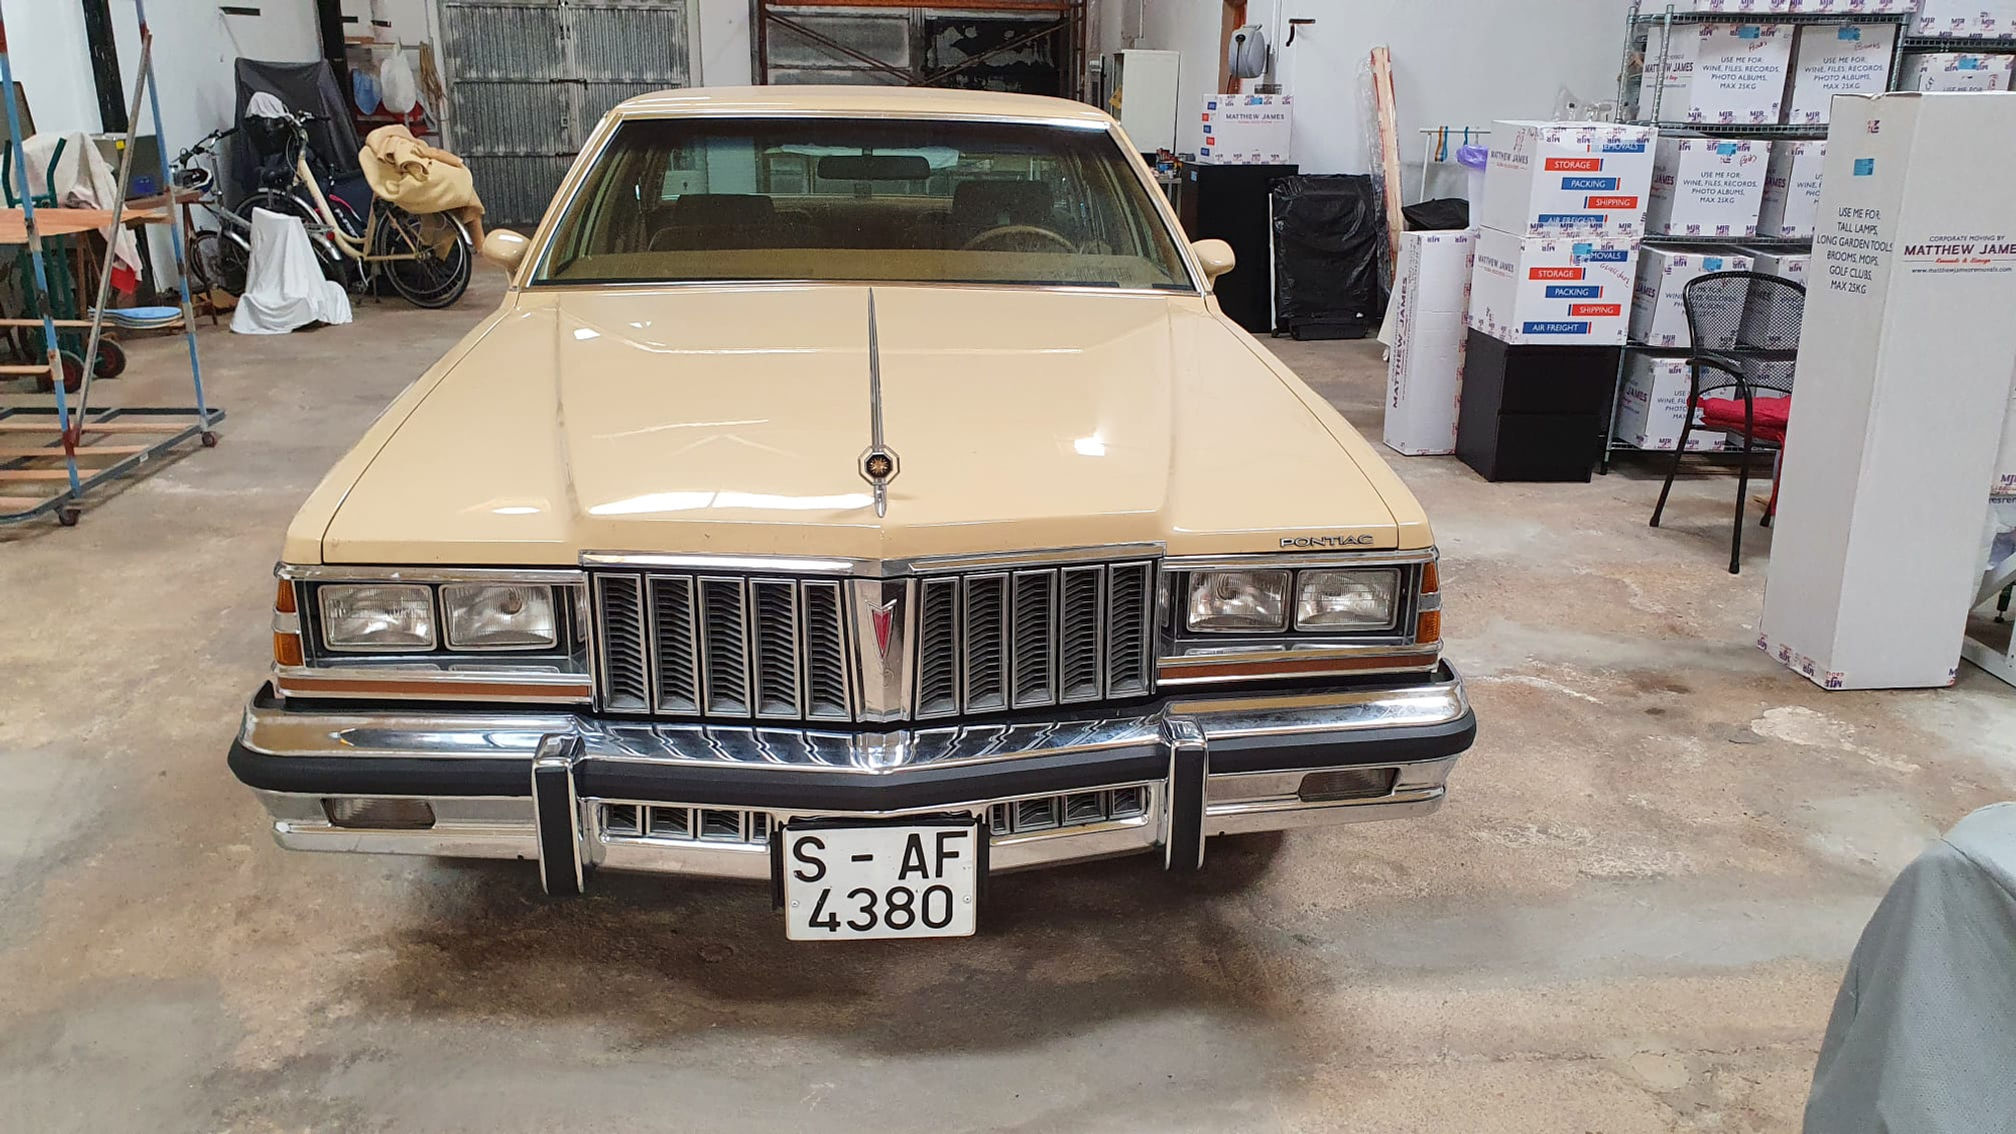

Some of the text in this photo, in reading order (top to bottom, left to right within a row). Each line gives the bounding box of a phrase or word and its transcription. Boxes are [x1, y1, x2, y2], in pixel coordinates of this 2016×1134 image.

[1673, 62, 1694, 72] JAMES
[1554, 160, 1590, 169] STORAGE
[1571, 180, 1605, 188] PACKING
[1655, 174, 1674, 186] JAMES
[1839, 207, 1881, 220] USE ME FOR
[1838, 222, 1878, 236] TALL LAMPS,
[1816, 235, 1838, 246] LONG
[1839, 236, 1870, 249] GARDEN
[1904, 244, 2016, 256] MATTHEW JAME
[1858, 252, 1879, 266] MOPS,
[1829, 266, 1872, 281] GOLF CLUBS,
[1554, 288, 1589, 296] PACKING
[1636, 283, 1656, 298] JAMES
[1830, 280, 1866, 294] MAX 25KG
[1392, 336, 1404, 408] MATTHEW
[1400, 276, 1408, 325] JAMES
[1626, 387, 1648, 402] JAMES
[1280, 534, 1374, 548] PONTIAC
[793, 836, 826, 882] S
[898, 830, 968, 880] AF
[808, 884, 953, 932] 4380
